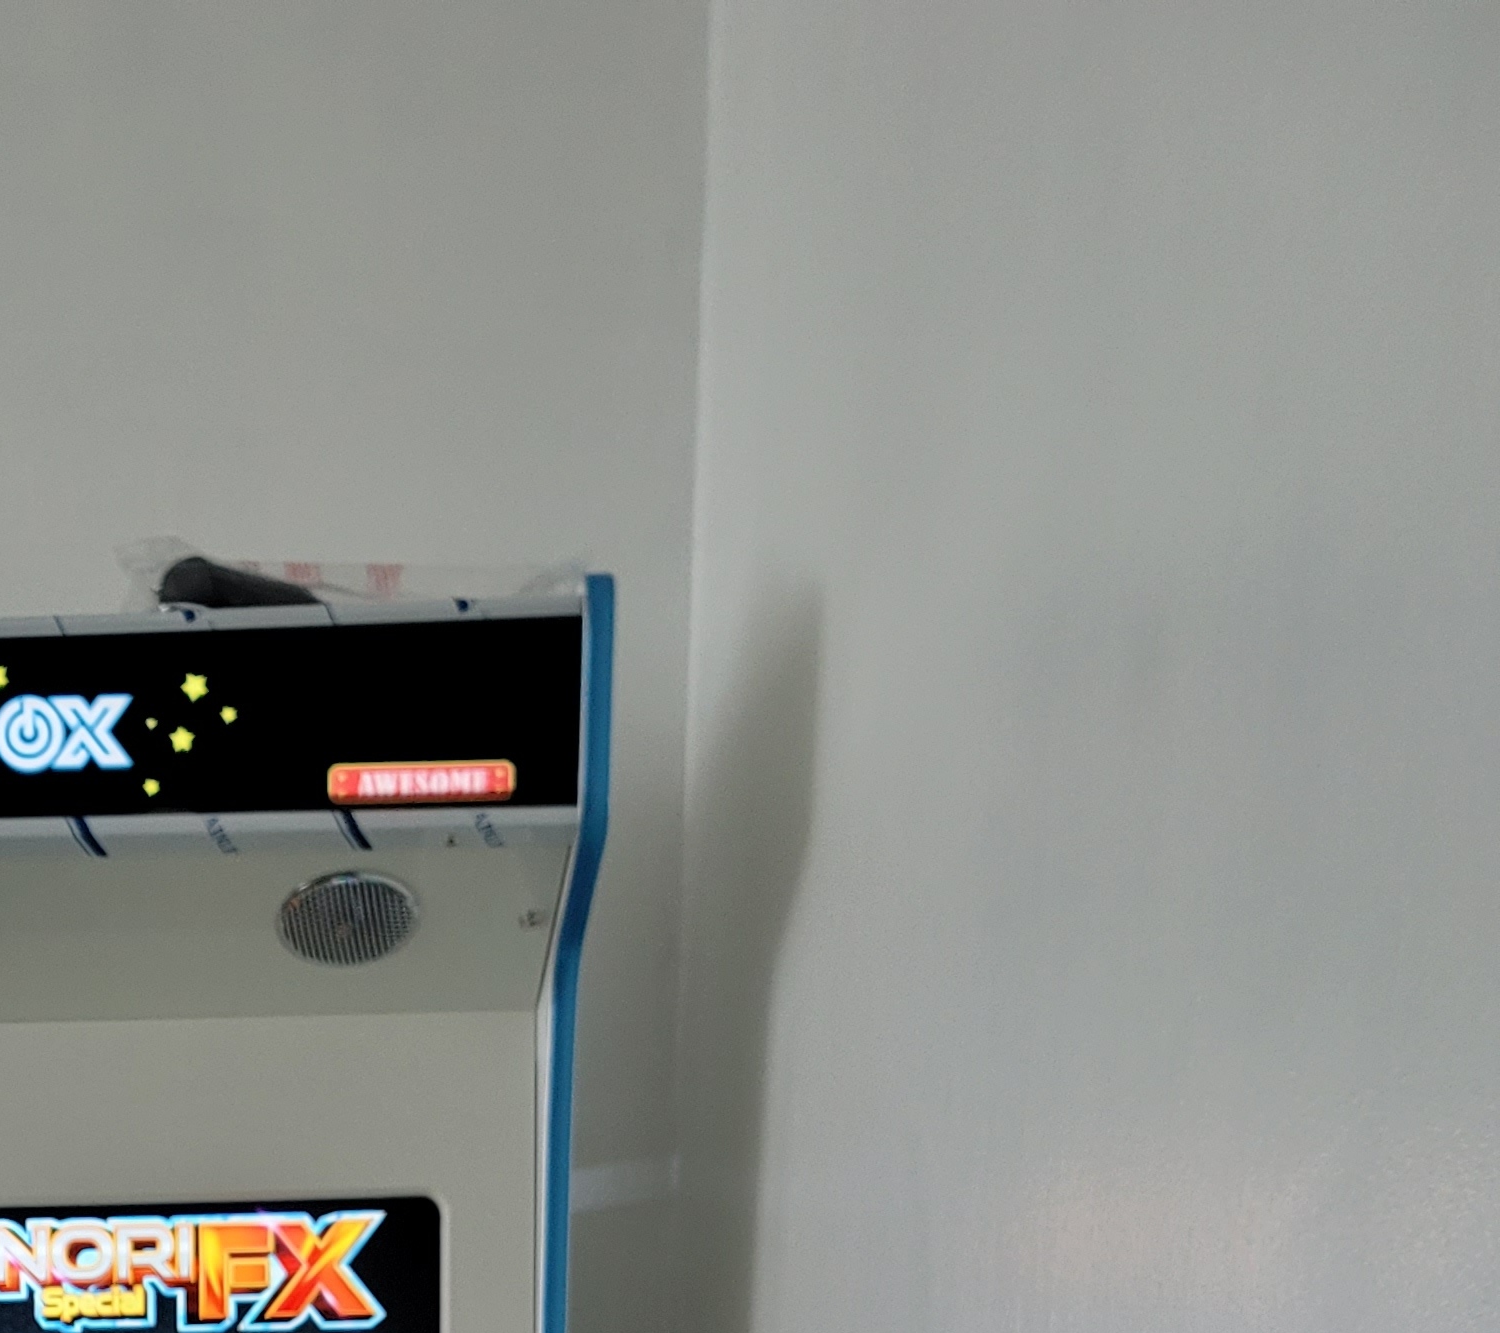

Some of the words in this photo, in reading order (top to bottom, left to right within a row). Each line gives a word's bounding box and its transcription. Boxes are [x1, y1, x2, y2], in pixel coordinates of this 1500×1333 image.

[357, 767, 489, 797] AWESOME
[198, 1212, 382, 1325] FX
[41, 1285, 146, 1322] Special
